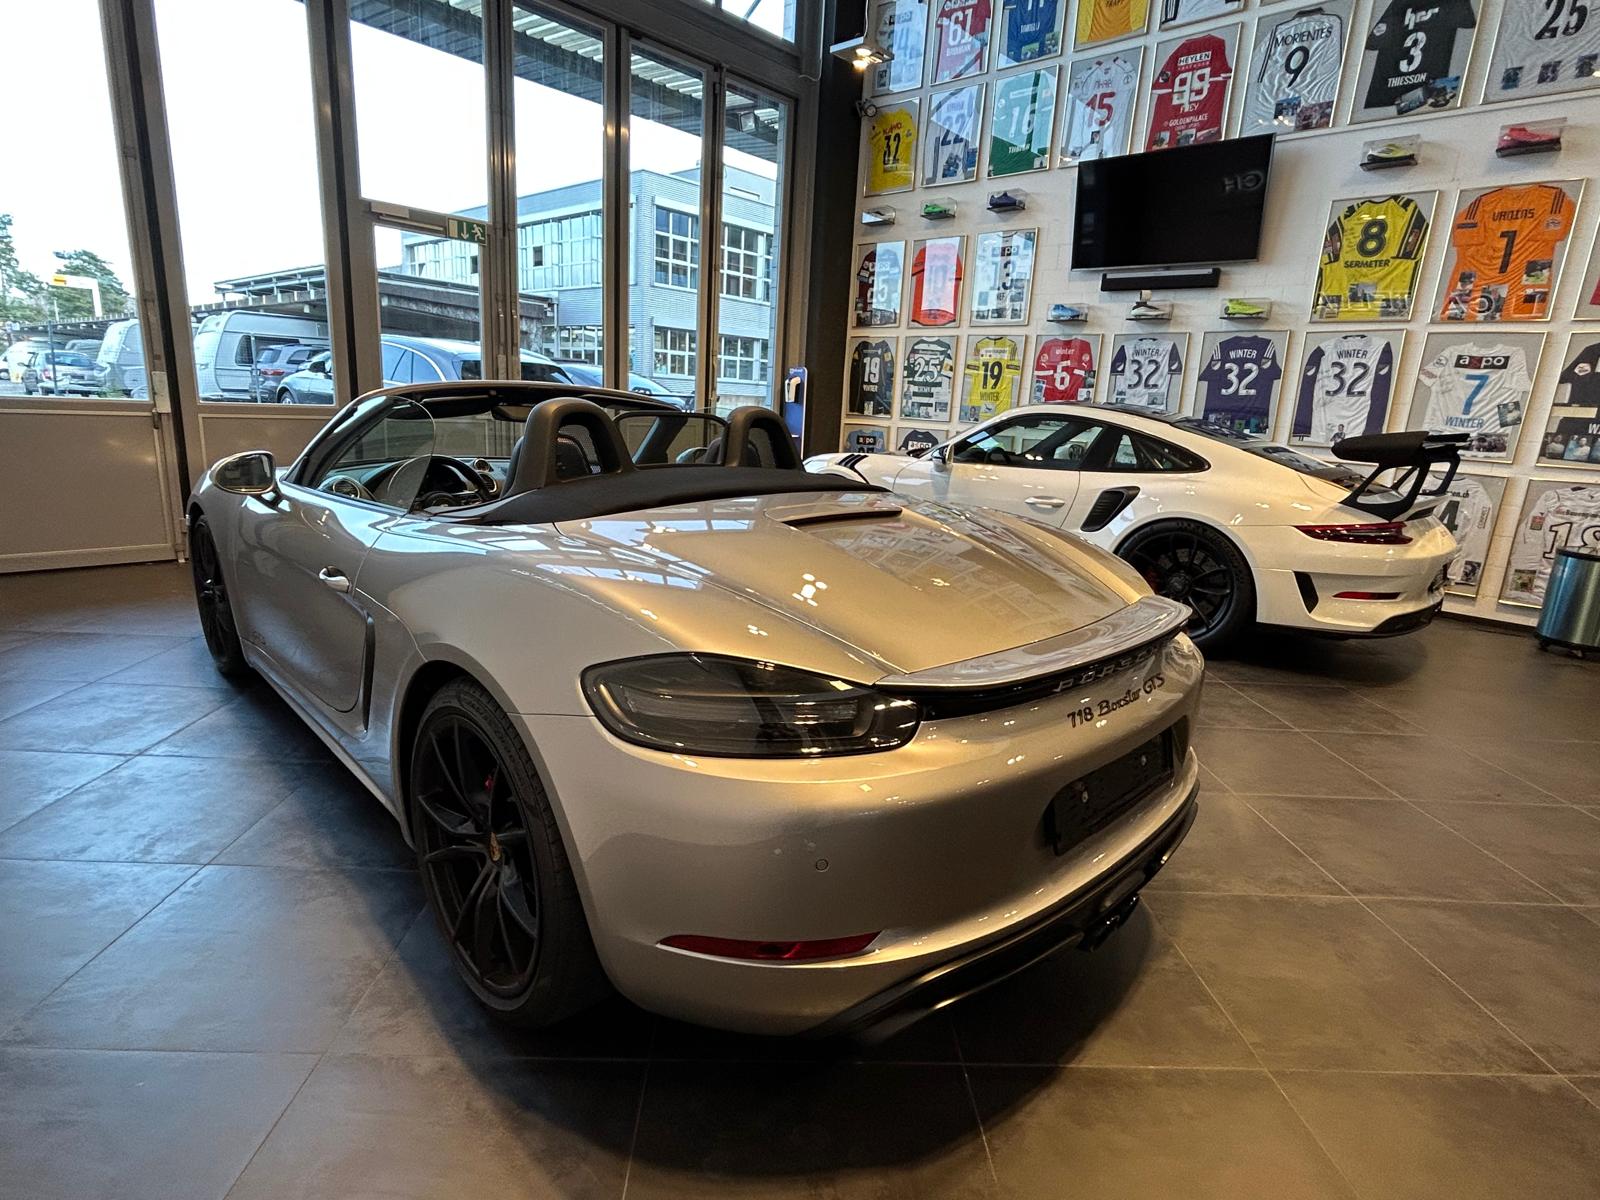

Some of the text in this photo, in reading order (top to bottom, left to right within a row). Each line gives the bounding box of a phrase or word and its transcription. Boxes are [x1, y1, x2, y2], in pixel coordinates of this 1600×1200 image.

[948, 8, 974, 47] 61
[1535, 0, 1588, 41] 25
[1275, 26, 1333, 49] MORIENTES
[1399, 31, 1427, 73] 3
[1178, 52, 1211, 66] HEYLEN
[1284, 45, 1310, 88] 9
[1172, 68, 1211, 112] 99
[1387, 73, 1427, 88] THIESSON
[1085, 91, 1116, 128] 15
[940, 113, 968, 147] 22
[882, 131, 901, 165] 32
[1356, 219, 1388, 257] 8
[1498, 230, 1517, 274] 1
[989, 260, 1017, 291] 13
[1343, 258, 1390, 270] SERMETER
[914, 355, 939, 383] 25
[1134, 347, 1161, 358] WINTER
[1229, 348, 1258, 360] WINTER
[1337, 349, 1368, 360] WINTER
[863, 356, 880, 384] 19
[982, 361, 1003, 390] 19
[1053, 359, 1071, 391] 6
[1127, 359, 1161, 390] 32
[1220, 362, 1260, 396] 32
[1325, 361, 1370, 397] 32
[1462, 374, 1489, 416] 7
[1444, 416, 1485, 429] WINTER
[1439, 500, 1461, 533] 4
[1067, 672, 1166, 728] 718 Boxster GTS
